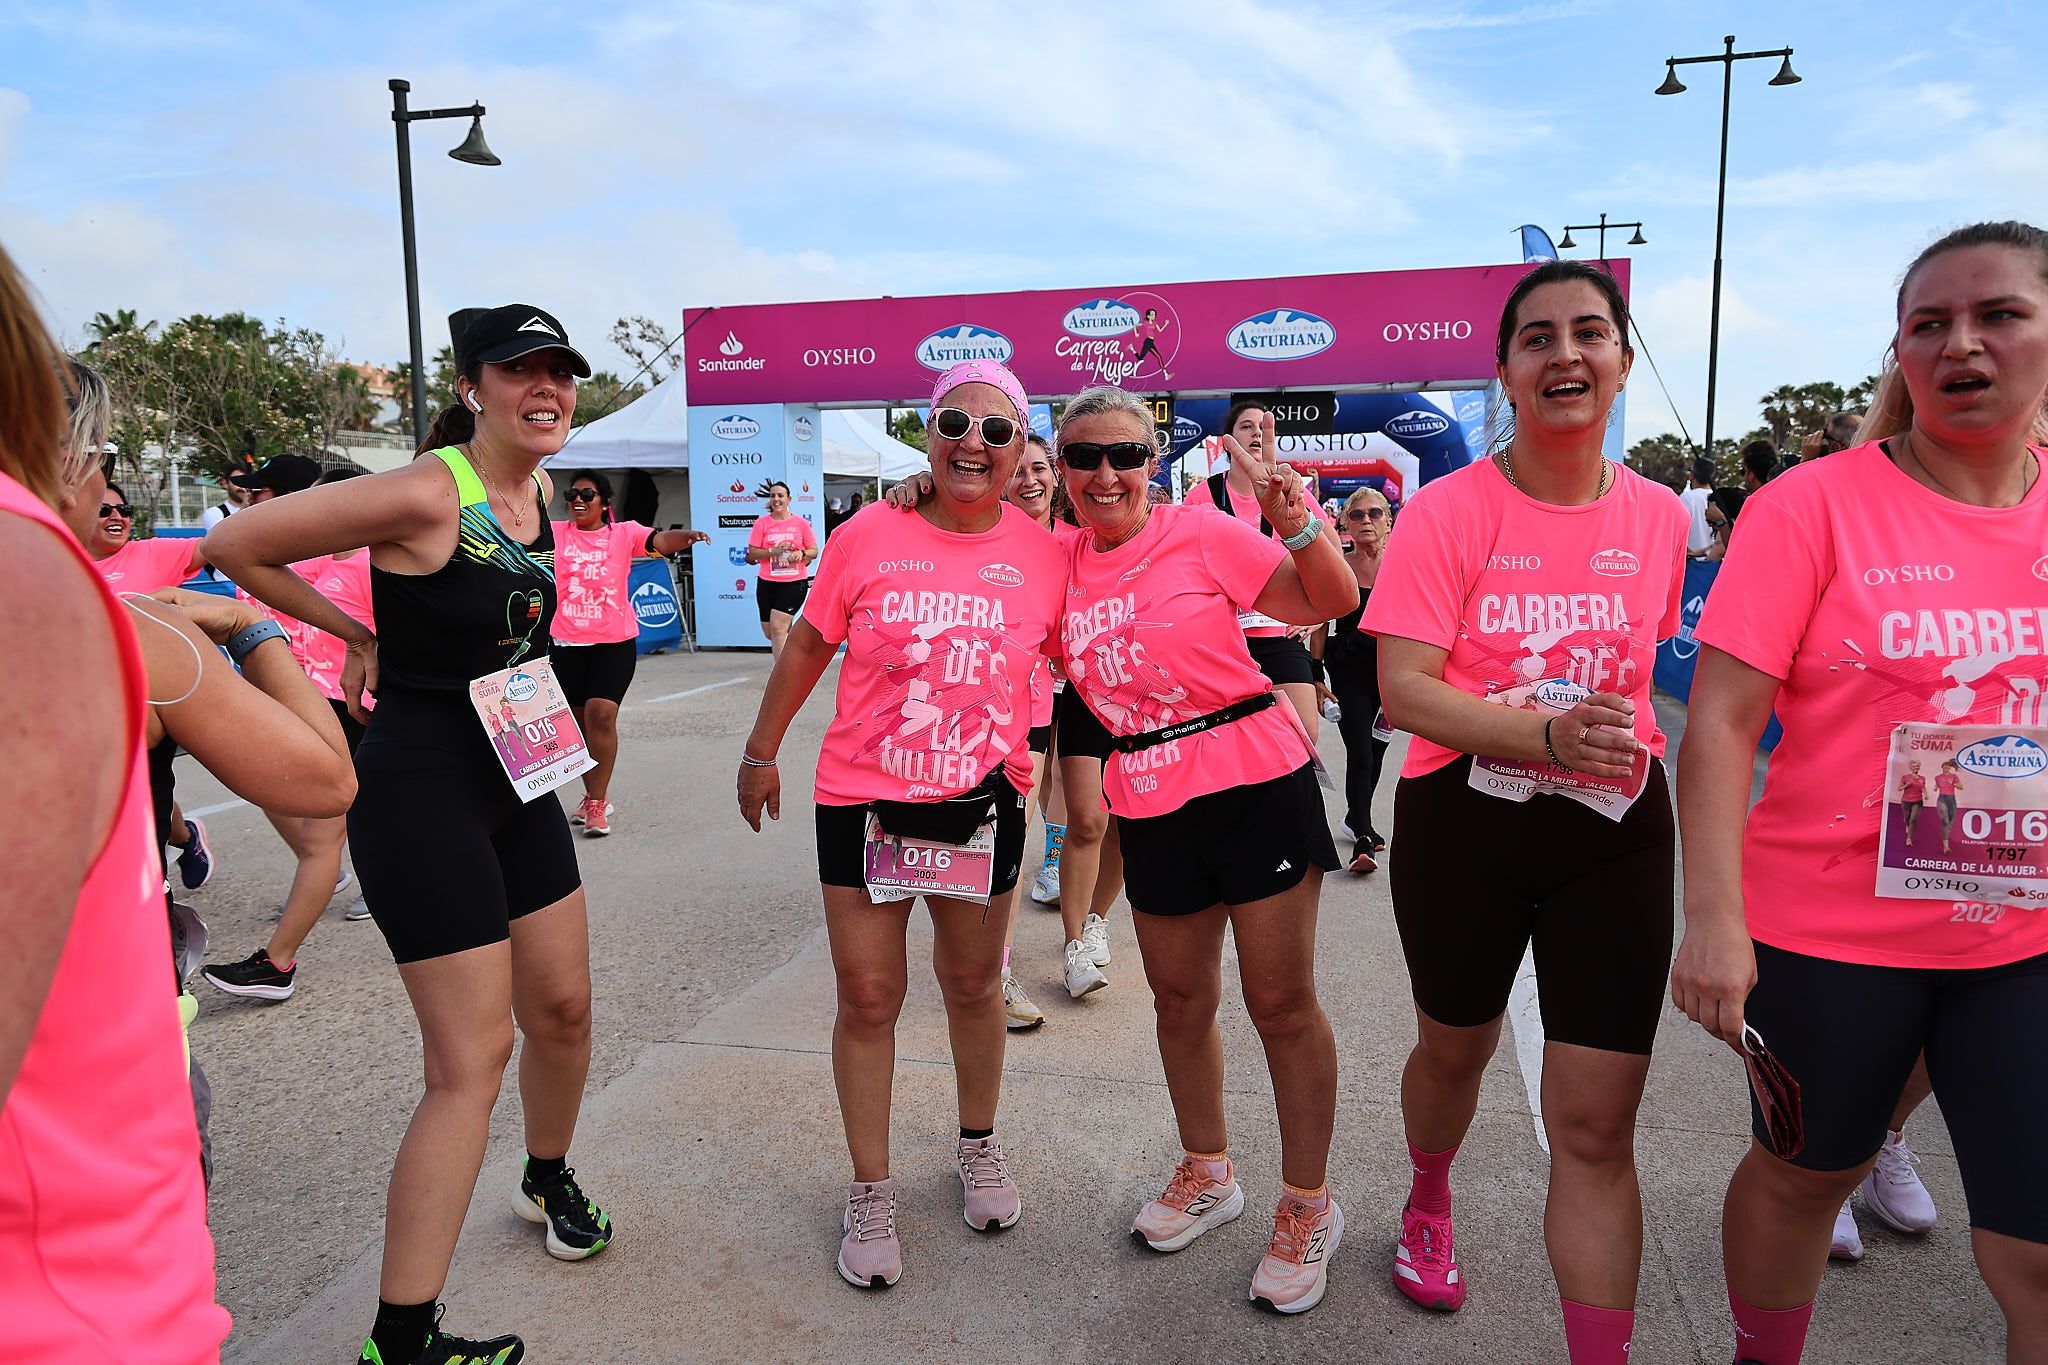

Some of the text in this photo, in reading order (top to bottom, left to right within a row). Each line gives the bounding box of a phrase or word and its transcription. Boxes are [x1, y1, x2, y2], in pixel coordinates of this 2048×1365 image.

[1069, 314, 1135, 329] ASTURIANA
[1235, 330, 1327, 348] ASTURIANA
[1382, 320, 1472, 343] OYSHO
[924, 344, 1005, 361] ASTURIANA
[1055, 336, 1121, 357] Carrera
[698, 356, 766, 373] Santander
[803, 346, 876, 368] OYSHO
[1071, 353, 1144, 386] de la Mujer
[715, 424, 757, 435] ASTURIANA
[1277, 433, 1367, 452] OYSHO
[711, 453, 762, 466] OYSHO
[716, 494, 758, 503] Santander
[878, 559, 934, 573] OYSHO
[1595, 558, 1636, 571] ASTURIANA
[982, 569, 1021, 583] ASTURIANA
[1863, 564, 1955, 586] OYSHO
[562, 601, 602, 619] MUJER
[881, 590, 1006, 632] CARRERA
[1061, 592, 1135, 642] RRERA
[1478, 593, 1632, 634] CARRERA
[943, 637, 989, 686] DE
[1095, 638, 1133, 688] DE
[478, 685, 501, 699] SUMA
[1542, 686, 1585, 703] ASTURI
[524, 717, 557, 743] 016
[929, 708, 962, 752] LA
[1174, 720, 1206, 735] Kalenji
[1910, 739, 1953, 751] SUMA
[1119, 739, 1181, 775] UJER
[1963, 750, 2042, 768] ASTURIANA
[880, 748, 978, 788] MUJER
[527, 770, 557, 791] OYSHO
[1131, 774, 1157, 794] 2026
[1489, 763, 1622, 794] CARRERA DE LA MUJER VALENCIA
[1961, 809, 2048, 842] 016
[903, 847, 951, 869] 016
[1985, 847, 2028, 861] 1797
[914, 869, 937, 879] 3003
[1904, 857, 2037, 876] CARRERA DE LA MUJER
[871, 876, 900, 885] CARRERA
[920, 881, 941, 889] MUJER
[946, 883, 976, 892] VALENCIA
[1904, 877, 1979, 894] OYSHO
[1950, 902, 2007, 924] 202
